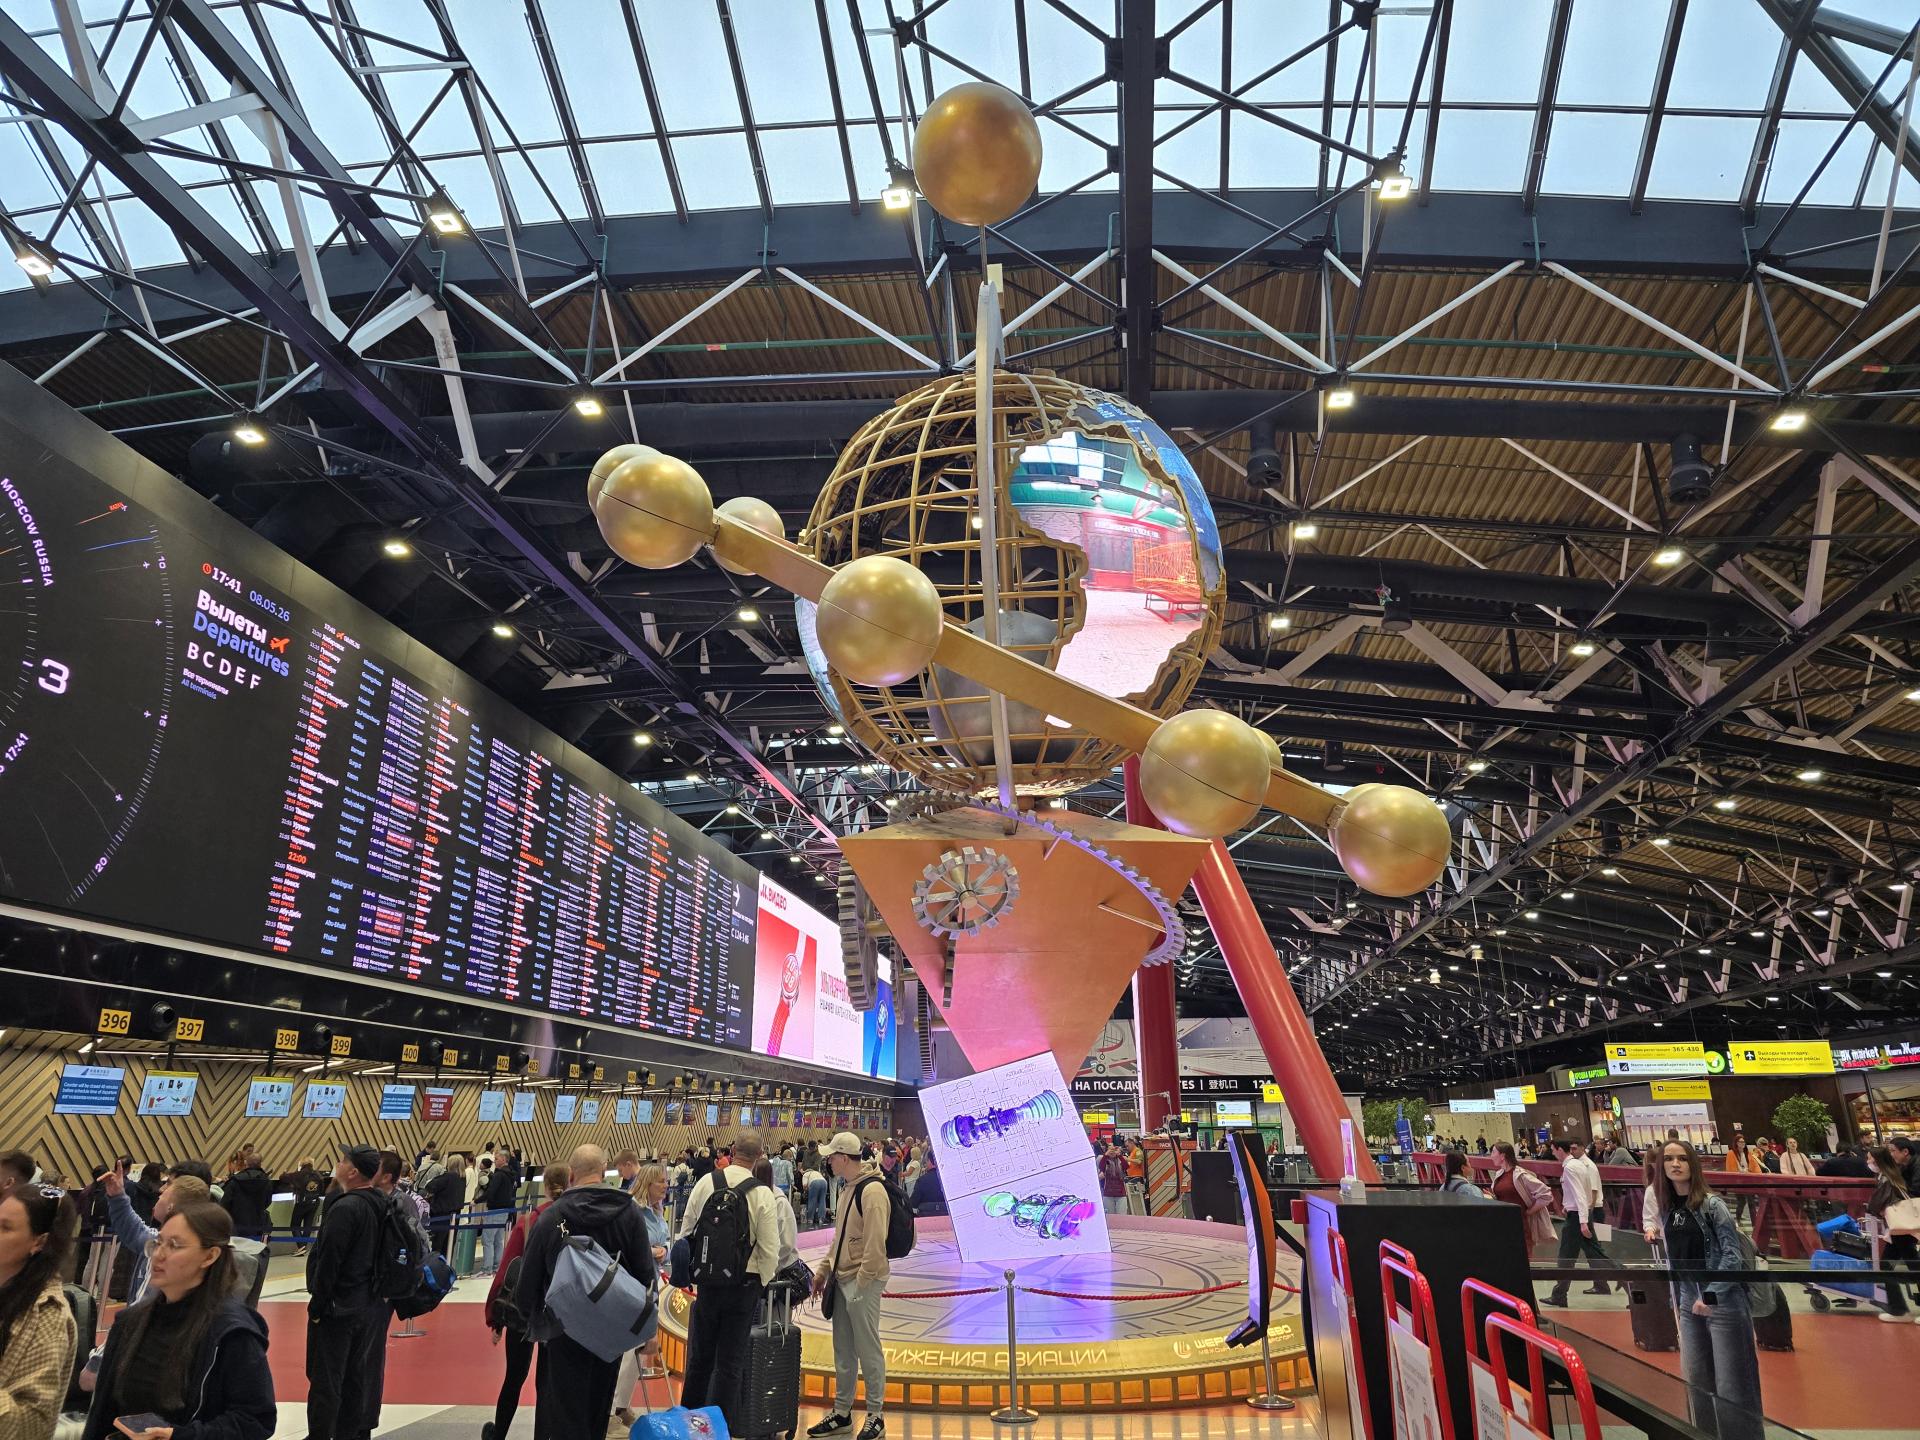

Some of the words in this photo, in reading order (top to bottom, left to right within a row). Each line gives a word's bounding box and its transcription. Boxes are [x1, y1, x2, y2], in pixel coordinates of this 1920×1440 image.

[0, 477, 39, 535] MOSCOW
[32, 538, 55, 587] RUSSIA
[212, 566, 242, 594] 17:41
[249, 590, 291, 622] 08.05.26
[196, 589, 268, 644] Вылеты
[192, 610, 290, 677] Departures
[187, 642, 200, 660] B
[202, 651, 215, 668] C
[219, 659, 232, 677] D
[234, 666, 245, 684] E
[250, 675, 262, 691] F
[38, 657, 70, 695] 3
[182, 667, 196, 680] Все
[195, 673, 229, 696] терминалы
[181, 678, 192, 689] All
[191, 681, 217, 700] terminals
[4, 732, 30, 761] 17:41
[94, 856, 109, 873] 20
[287, 851, 307, 864] 22:00
[101, 1013, 129, 1030] 396
[178, 1021, 202, 1037] 397
[277, 1032, 297, 1047] 398
[333, 1039, 350, 1052] 399
[403, 1047, 418, 1060] 400
[444, 1052, 457, 1063] 401
[1851, 1046, 1880, 1060] market
[498, 1058, 509, 1068] 402
[528, 1062, 539, 1071] 403
[571, 1066, 580, 1075] 404
[1075, 1081, 1091, 1091] НА
[1093, 1081, 1140, 1091] ПОСАДК
[1208, 1079, 1238, 1090] 登机口
[1194, 1324, 1292, 1349] ШЕРЕВО
[882, 1348, 987, 1367] ТИЖЕНИЯ
[995, 1348, 1108, 1368] АВИАЦИИ
